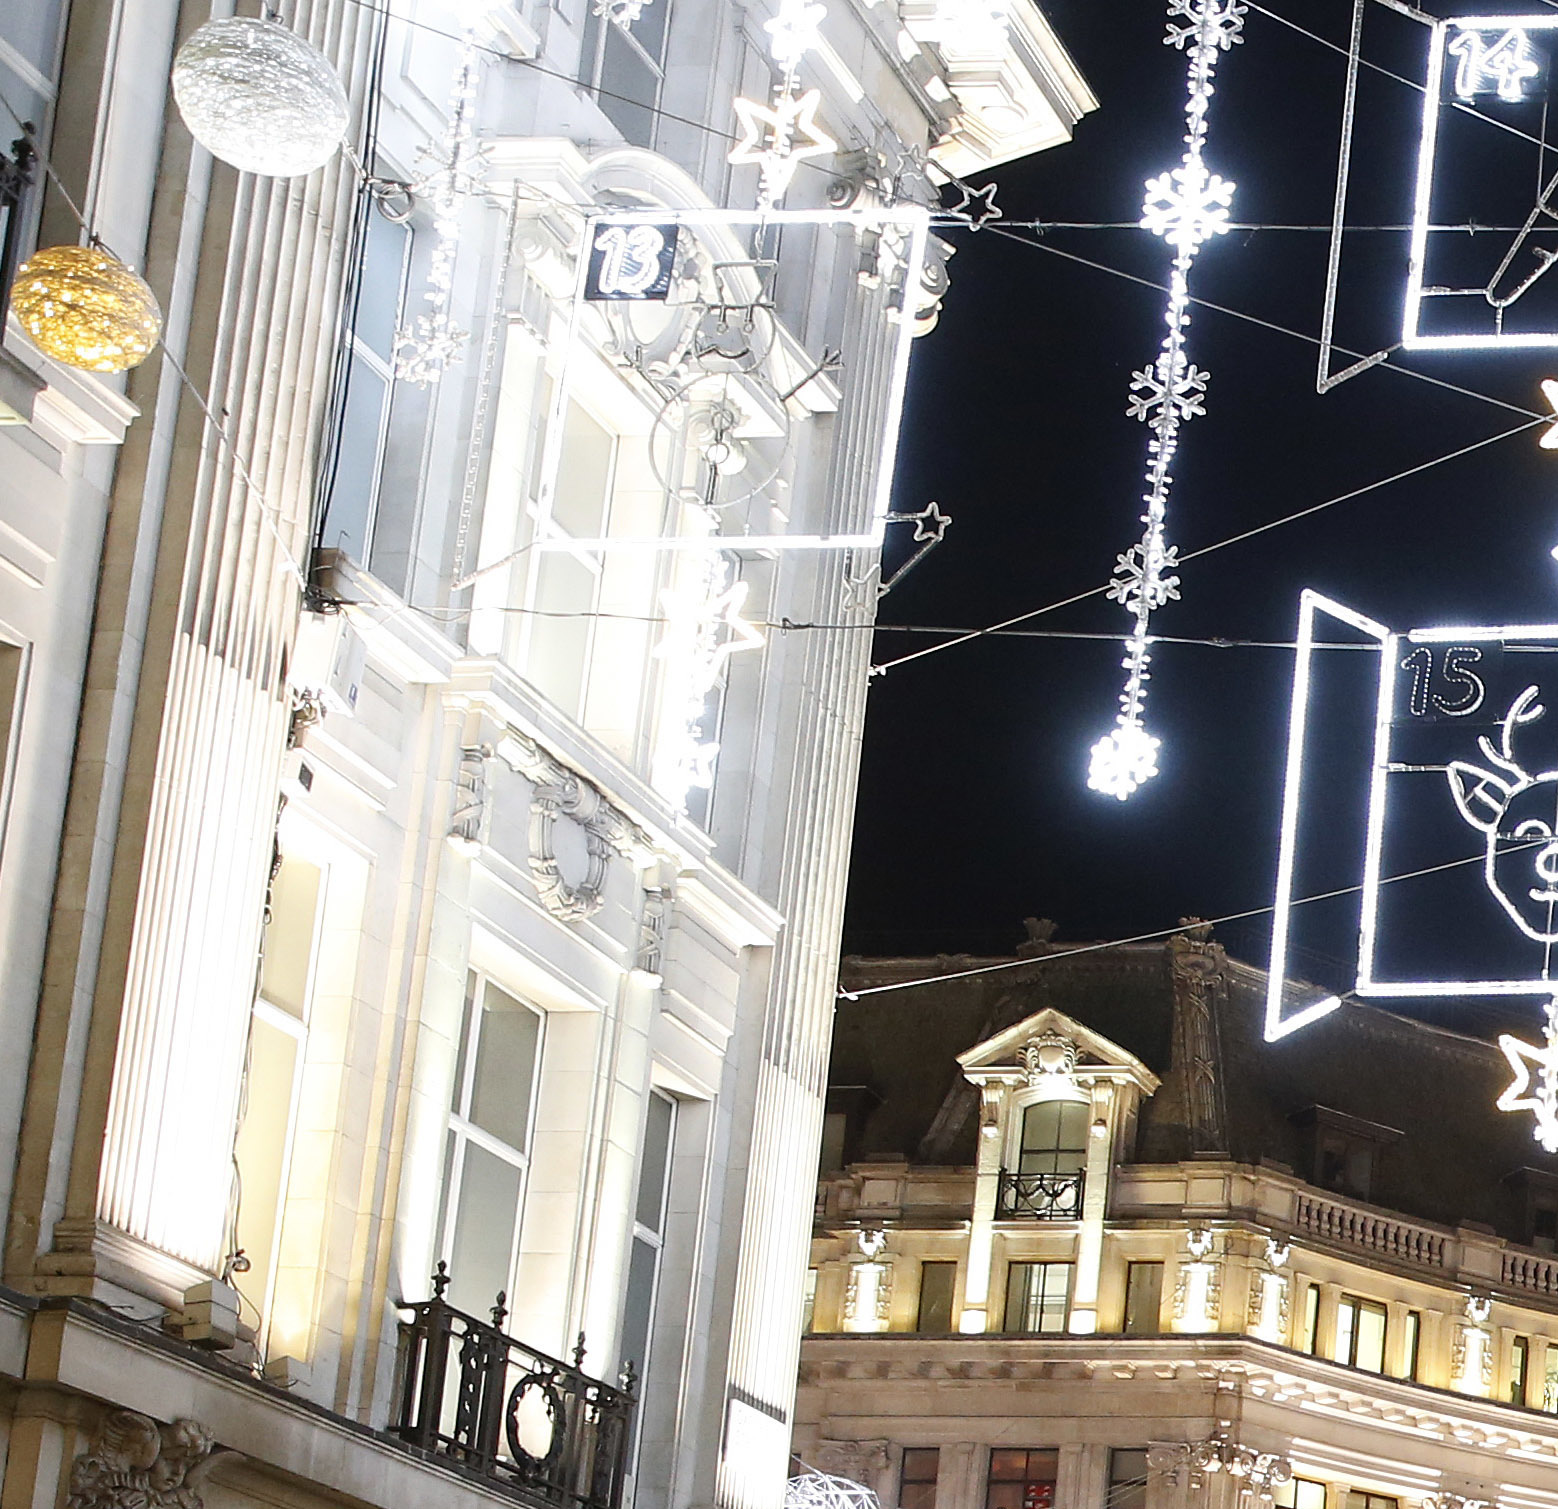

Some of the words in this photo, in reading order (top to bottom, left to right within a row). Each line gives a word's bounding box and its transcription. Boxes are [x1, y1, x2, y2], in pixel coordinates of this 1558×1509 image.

[1448, 29, 1539, 99] 14
[594, 225, 665, 293] 13
[1401, 646, 1486, 716] 15
